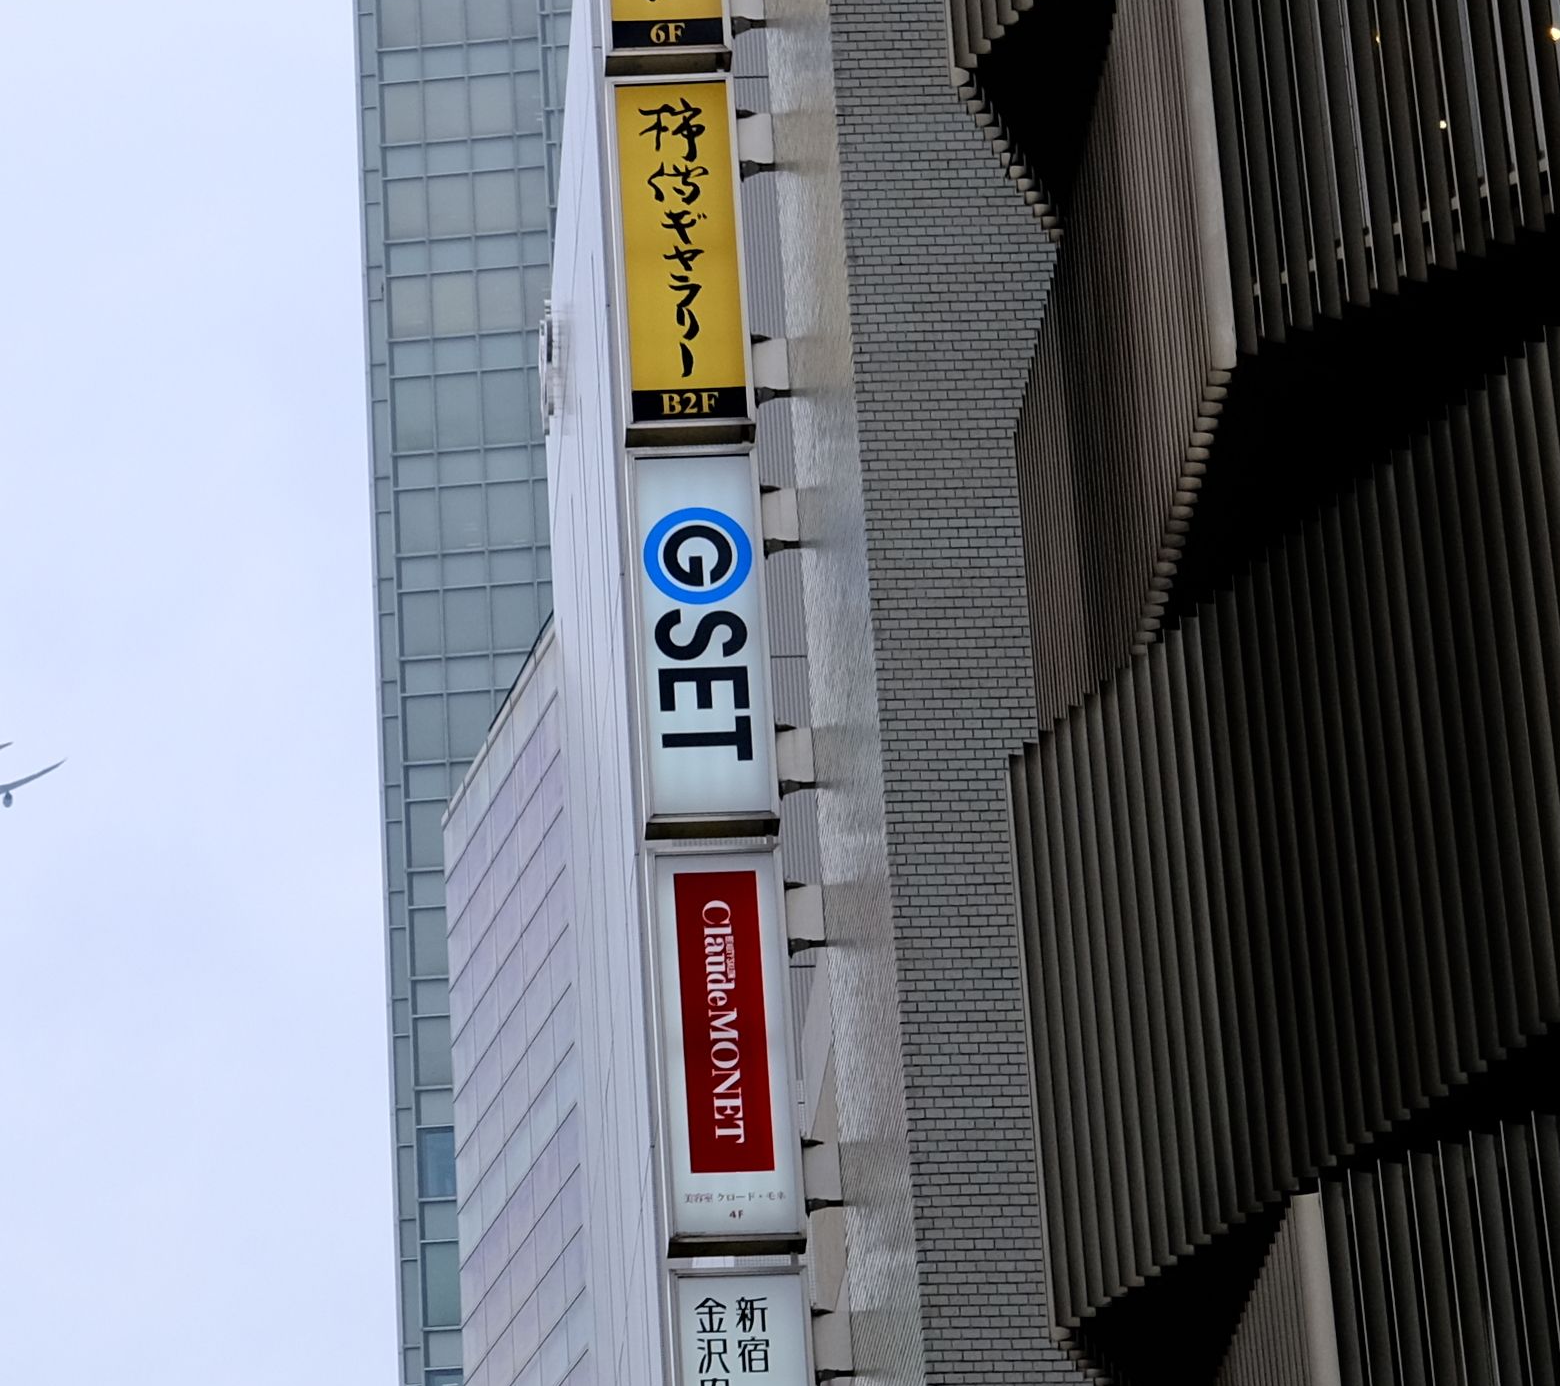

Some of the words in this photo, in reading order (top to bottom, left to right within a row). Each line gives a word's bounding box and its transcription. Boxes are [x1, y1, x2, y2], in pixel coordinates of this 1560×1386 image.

[648, 21, 686, 44] 6F
[660, 391, 720, 416] B2F
[701, 899, 735, 1007] Claude
[708, 1008, 746, 1144] MONET
[729, 1209, 744, 1219] 4F
[734, 1295, 771, 1375] 新宿
